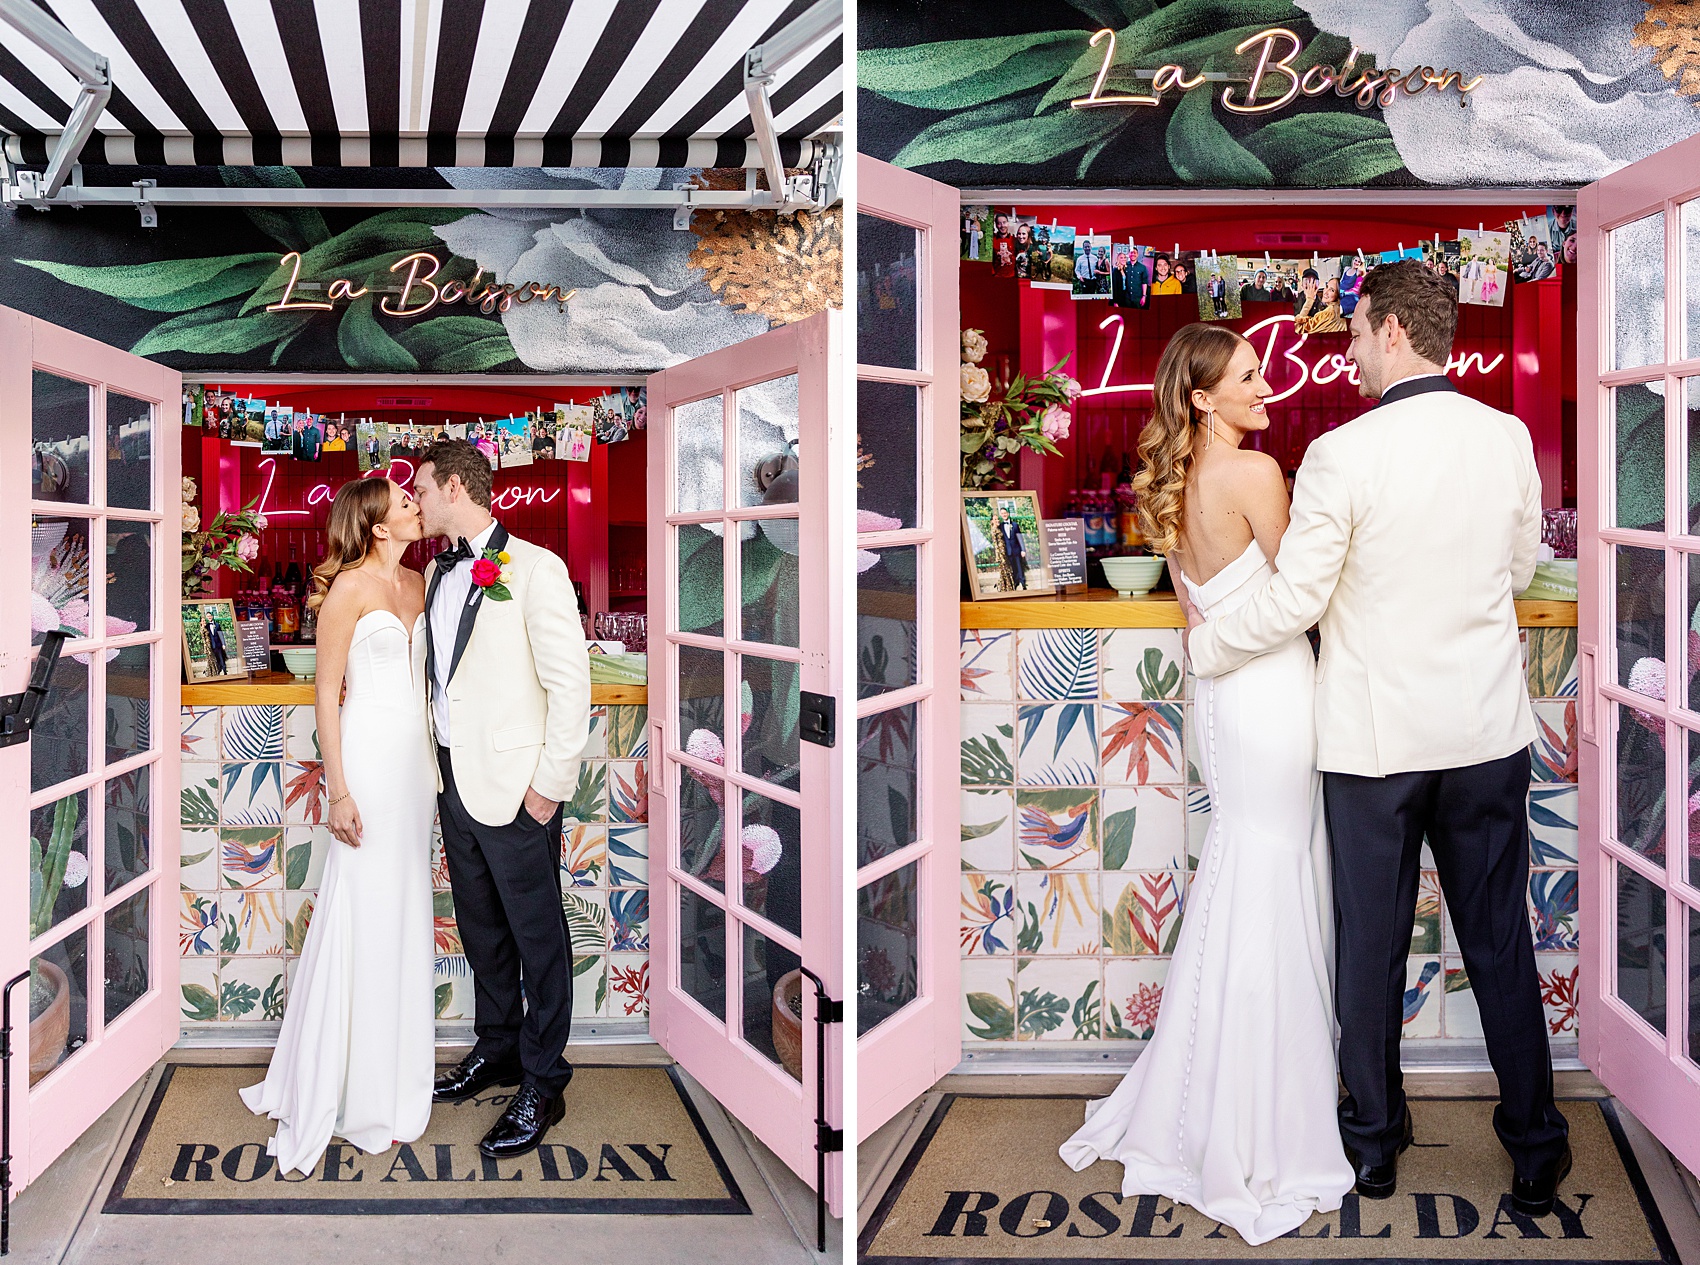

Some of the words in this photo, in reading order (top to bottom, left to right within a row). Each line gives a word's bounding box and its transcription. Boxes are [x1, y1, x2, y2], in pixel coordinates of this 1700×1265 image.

[1071, 28, 1205, 109] La
[1221, 28, 1484, 115] Boisson
[266, 251, 368, 312] La
[380, 252, 577, 318] Boisson
[1080, 314, 1155, 397] L
[537, 1143, 677, 1182] DAY
[1408, 1193, 1595, 1240] DAY
